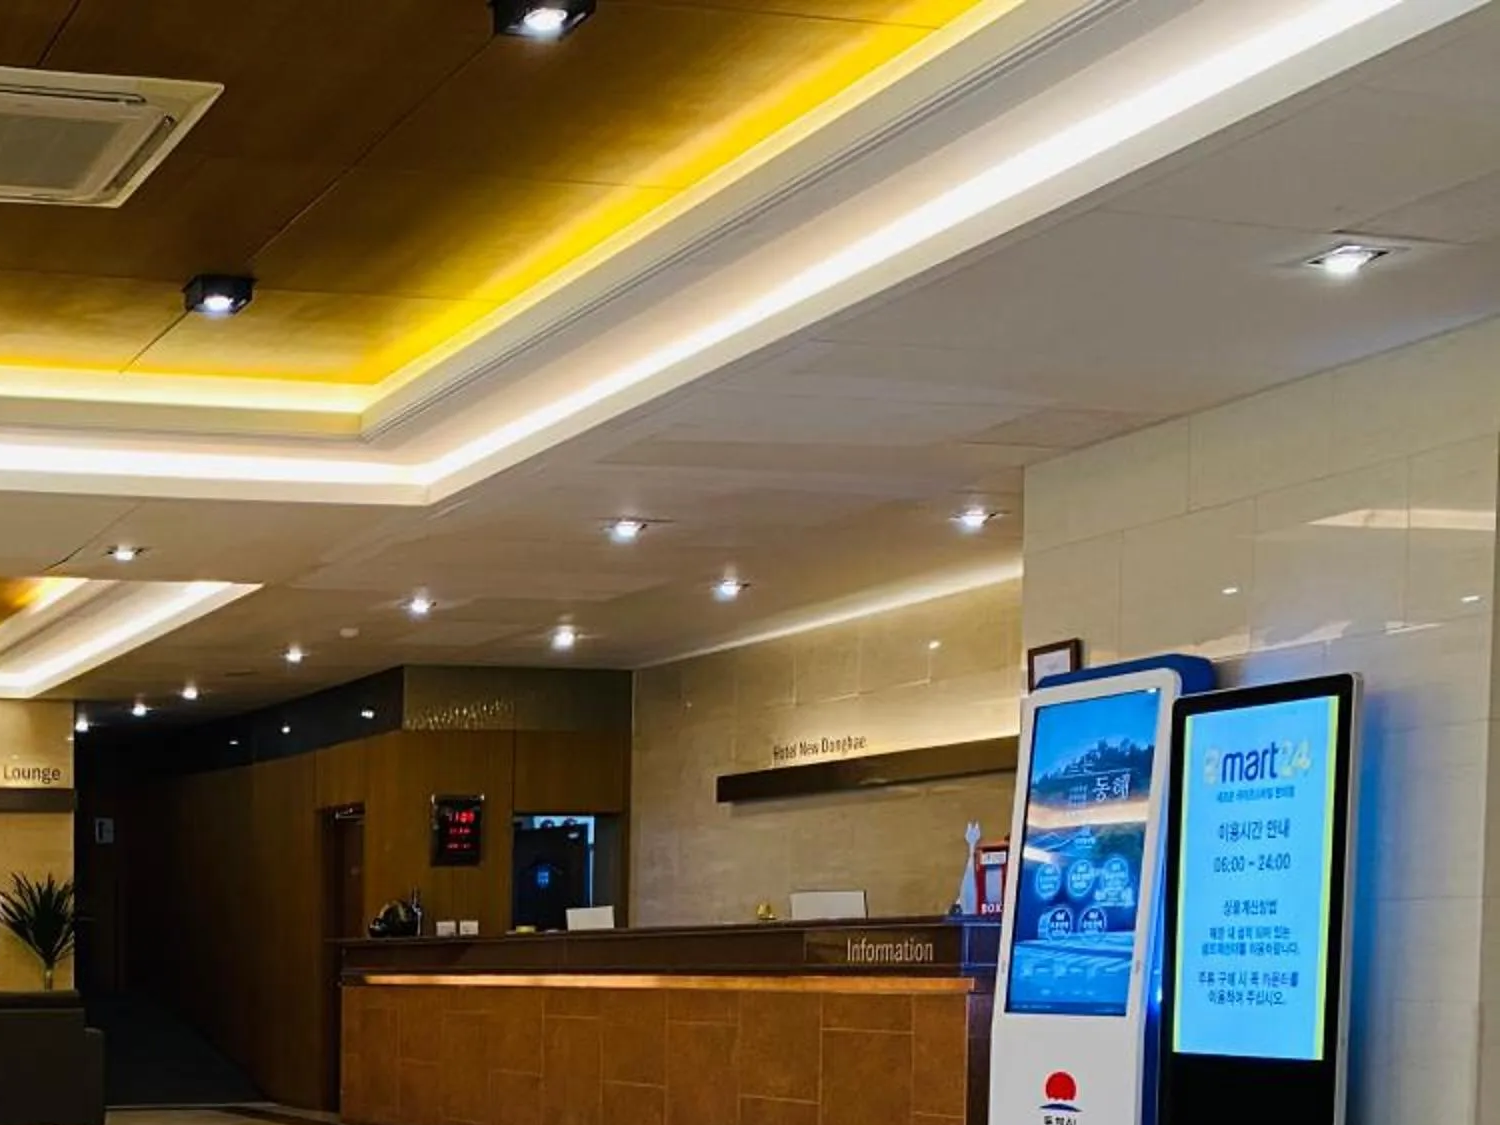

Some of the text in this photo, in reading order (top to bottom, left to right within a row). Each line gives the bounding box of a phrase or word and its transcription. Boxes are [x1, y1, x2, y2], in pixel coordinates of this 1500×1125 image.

[821, 736, 867, 755] Donghae
[2, 764, 61, 784] Lounge
[1218, 817, 1291, 842] 이용시간 안내
[1257, 852, 1291, 871] 24:00
[847, 937, 933, 962] Information
